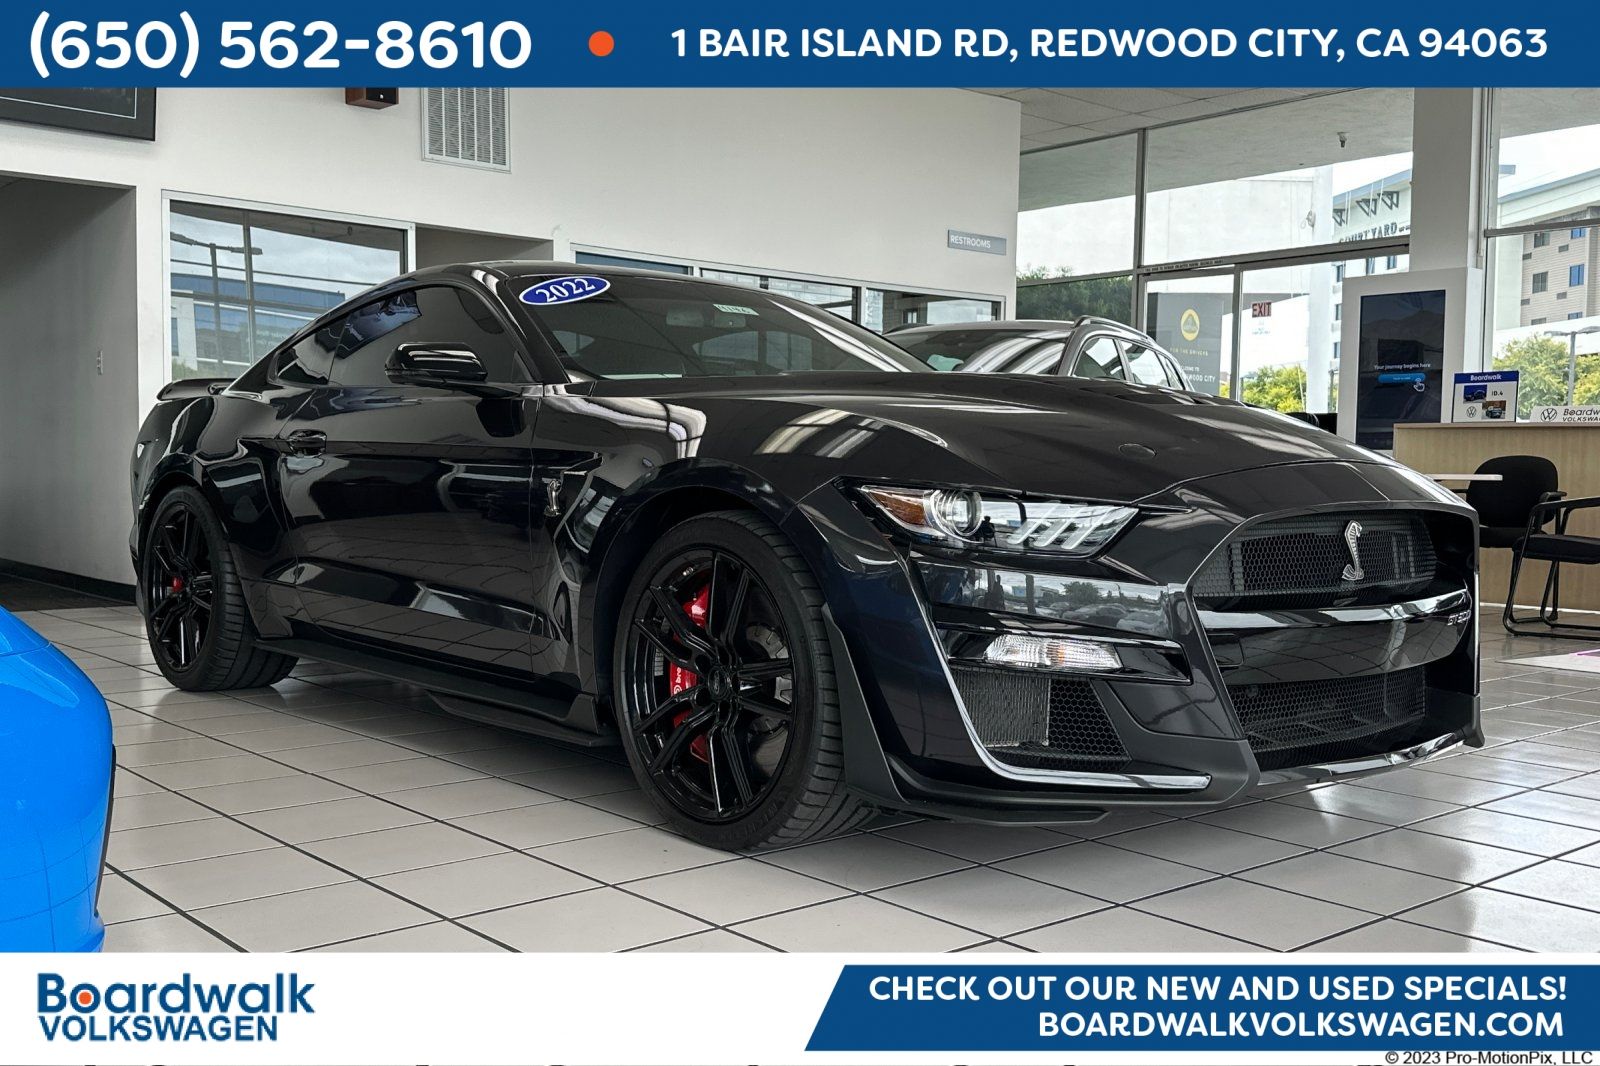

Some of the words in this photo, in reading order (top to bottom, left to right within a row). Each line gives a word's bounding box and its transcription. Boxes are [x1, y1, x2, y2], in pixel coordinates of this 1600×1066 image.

[1340, 222, 1397, 243] URTYARD
[950, 235, 991, 249] RESTROOMS
[535, 278, 596, 303] 2022
[1252, 302, 1271, 318] EXIT
[1203, 374, 1216, 383] CITY
[1470, 374, 1502, 382] Boardwalk
